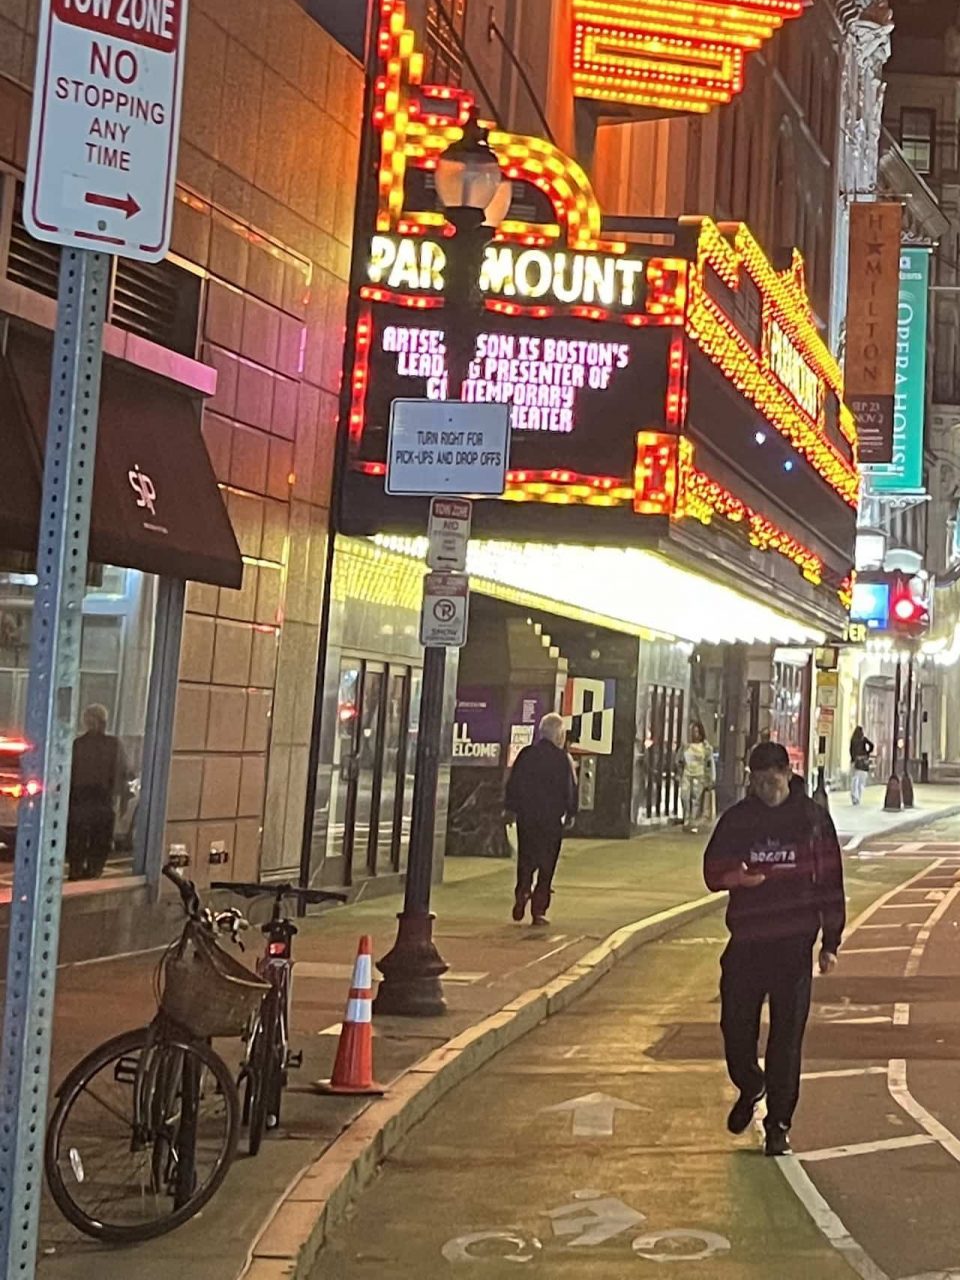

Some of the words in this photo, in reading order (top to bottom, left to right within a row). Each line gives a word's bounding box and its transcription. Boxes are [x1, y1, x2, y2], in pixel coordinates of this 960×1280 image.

[90, 41, 138, 84] NO
[56, 77, 165, 125] STOPPING
[89, 117, 130, 143] ANY
[85, 142, 131, 171] TIME
[367, 235, 643, 306] PARMOUNT
[518, 336, 540, 361] IS
[544, 339, 629, 368] BOSTON'S
[485, 358, 585, 388] PRESENTER
[588, 365, 612, 389] OF
[417, 430, 439, 445] TURN
[441, 431, 464, 445] RIGHT
[467, 432, 483, 446] FOR
[395, 450, 434, 464] PICK-UPS
[436, 451, 453, 464] AND
[456, 451, 478, 465] DROP
[481, 452, 501, 466] OFFS
[453, 743, 499, 757] ELCOME
